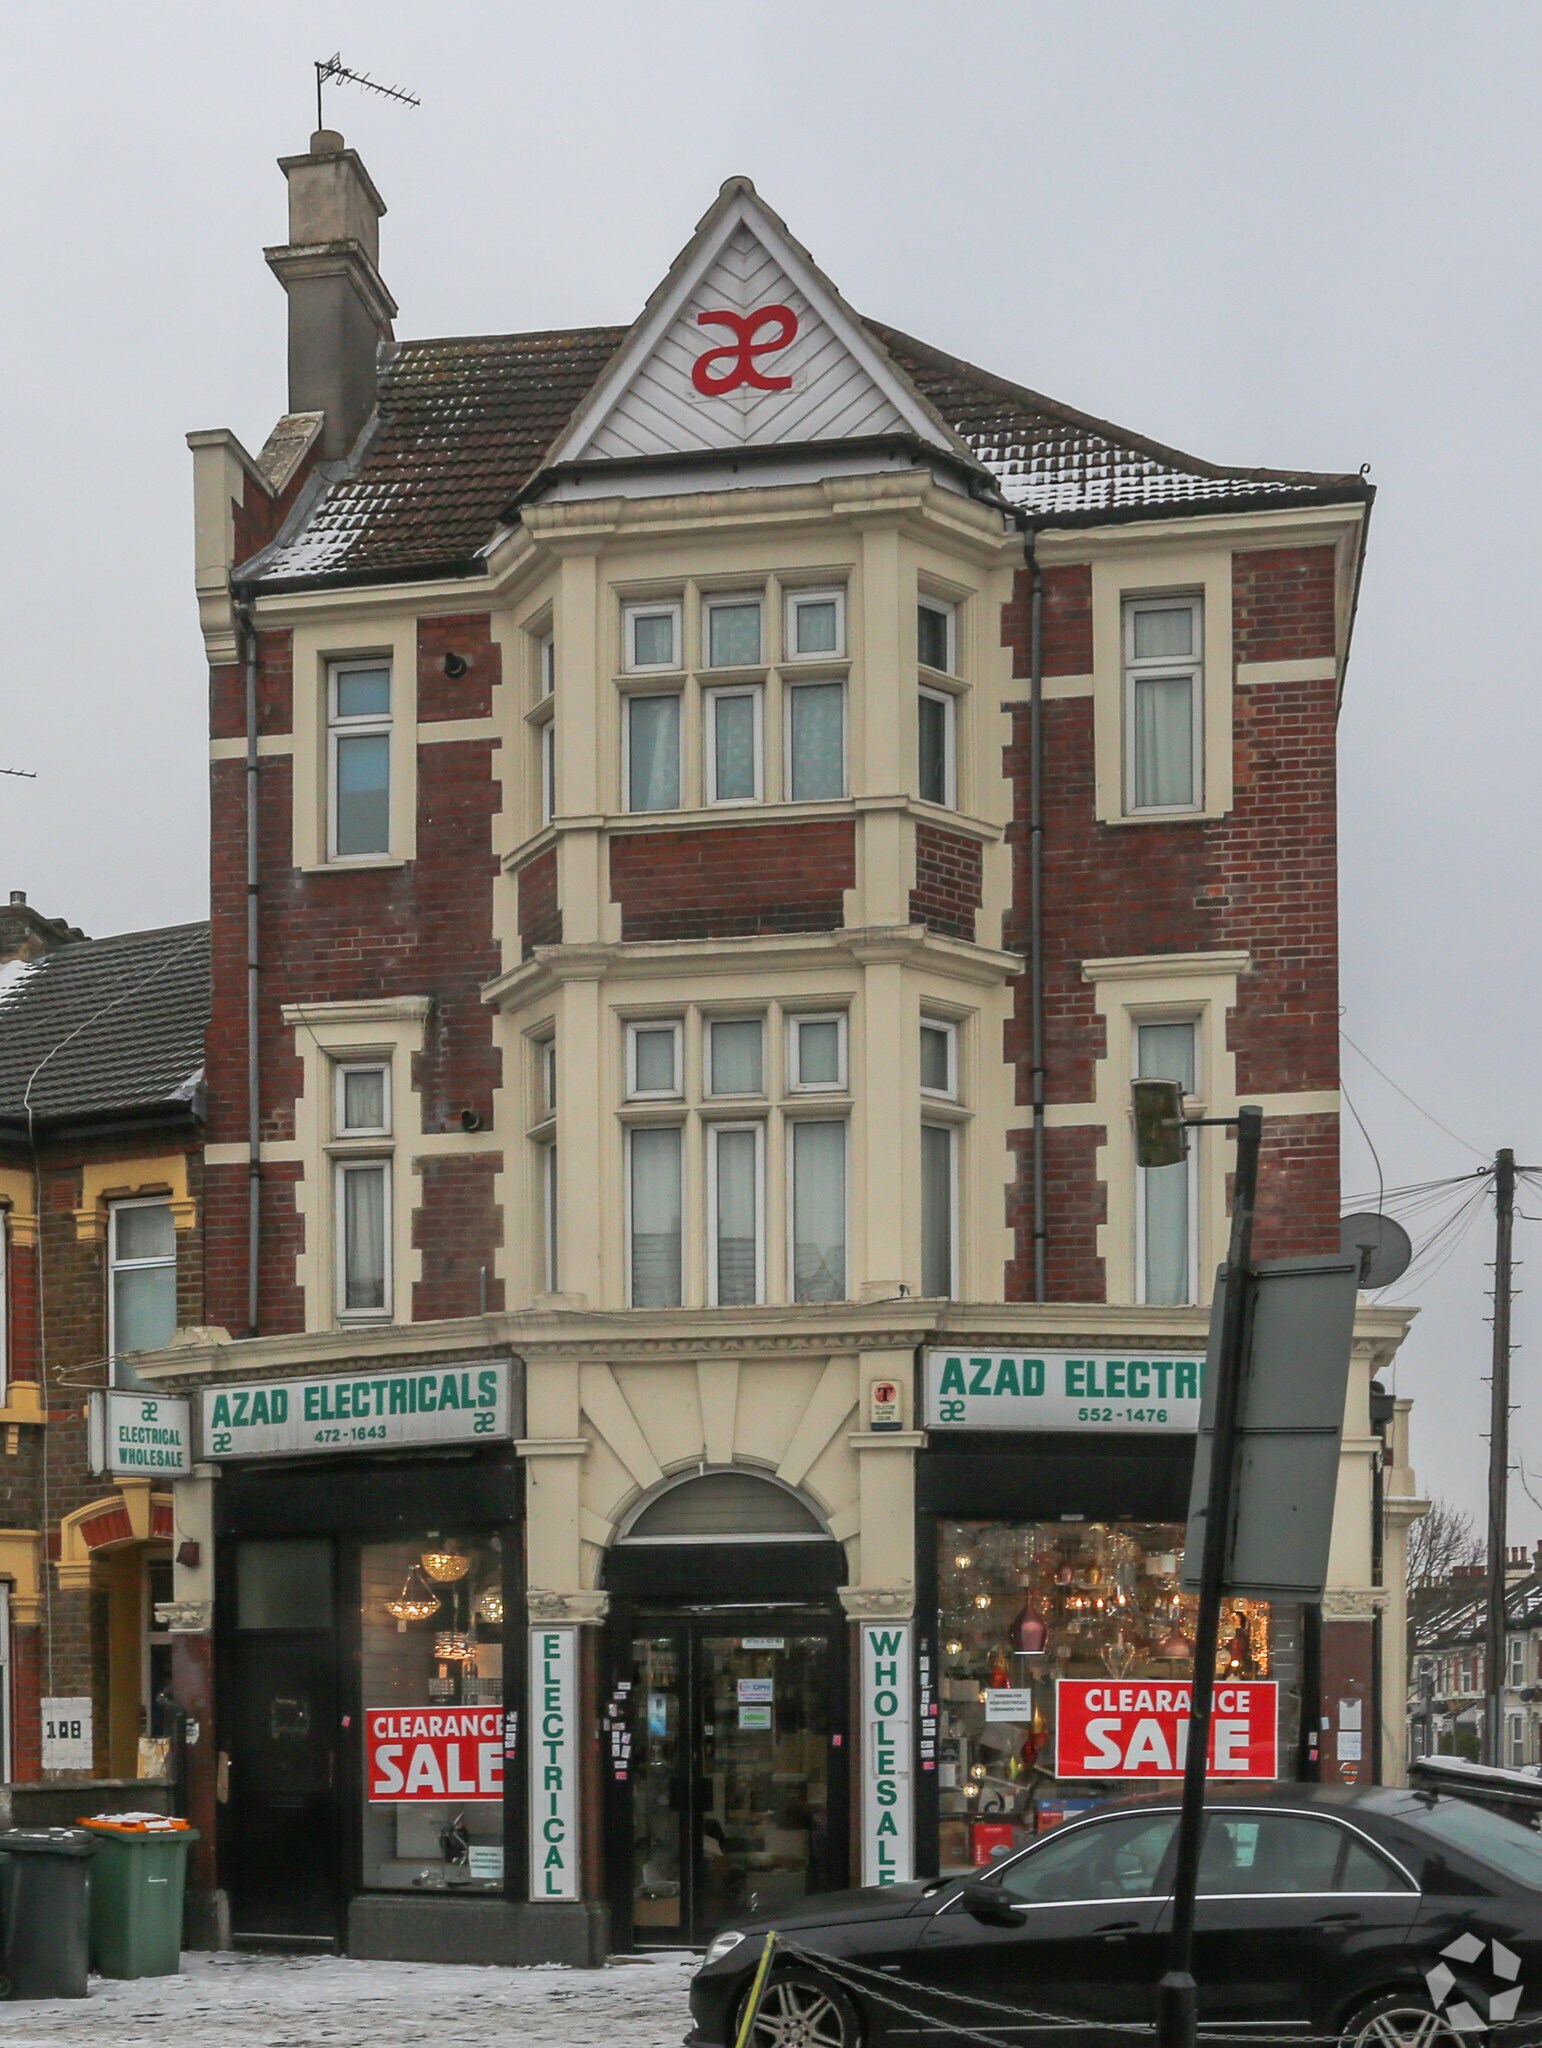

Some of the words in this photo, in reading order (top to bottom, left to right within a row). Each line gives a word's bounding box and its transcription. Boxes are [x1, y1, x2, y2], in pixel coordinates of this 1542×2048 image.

[939, 1357, 1045, 1396] AZAD
[211, 1388, 288, 1428] AZAD
[304, 1371, 497, 1421] ELECTRICALS
[118, 1447, 183, 1468] WHOLESALE
[119, 1425, 182, 1446] ELECTRICAL
[374, 1743, 503, 1794] SALE
[542, 1634, 565, 1895] ELECTRICAL
